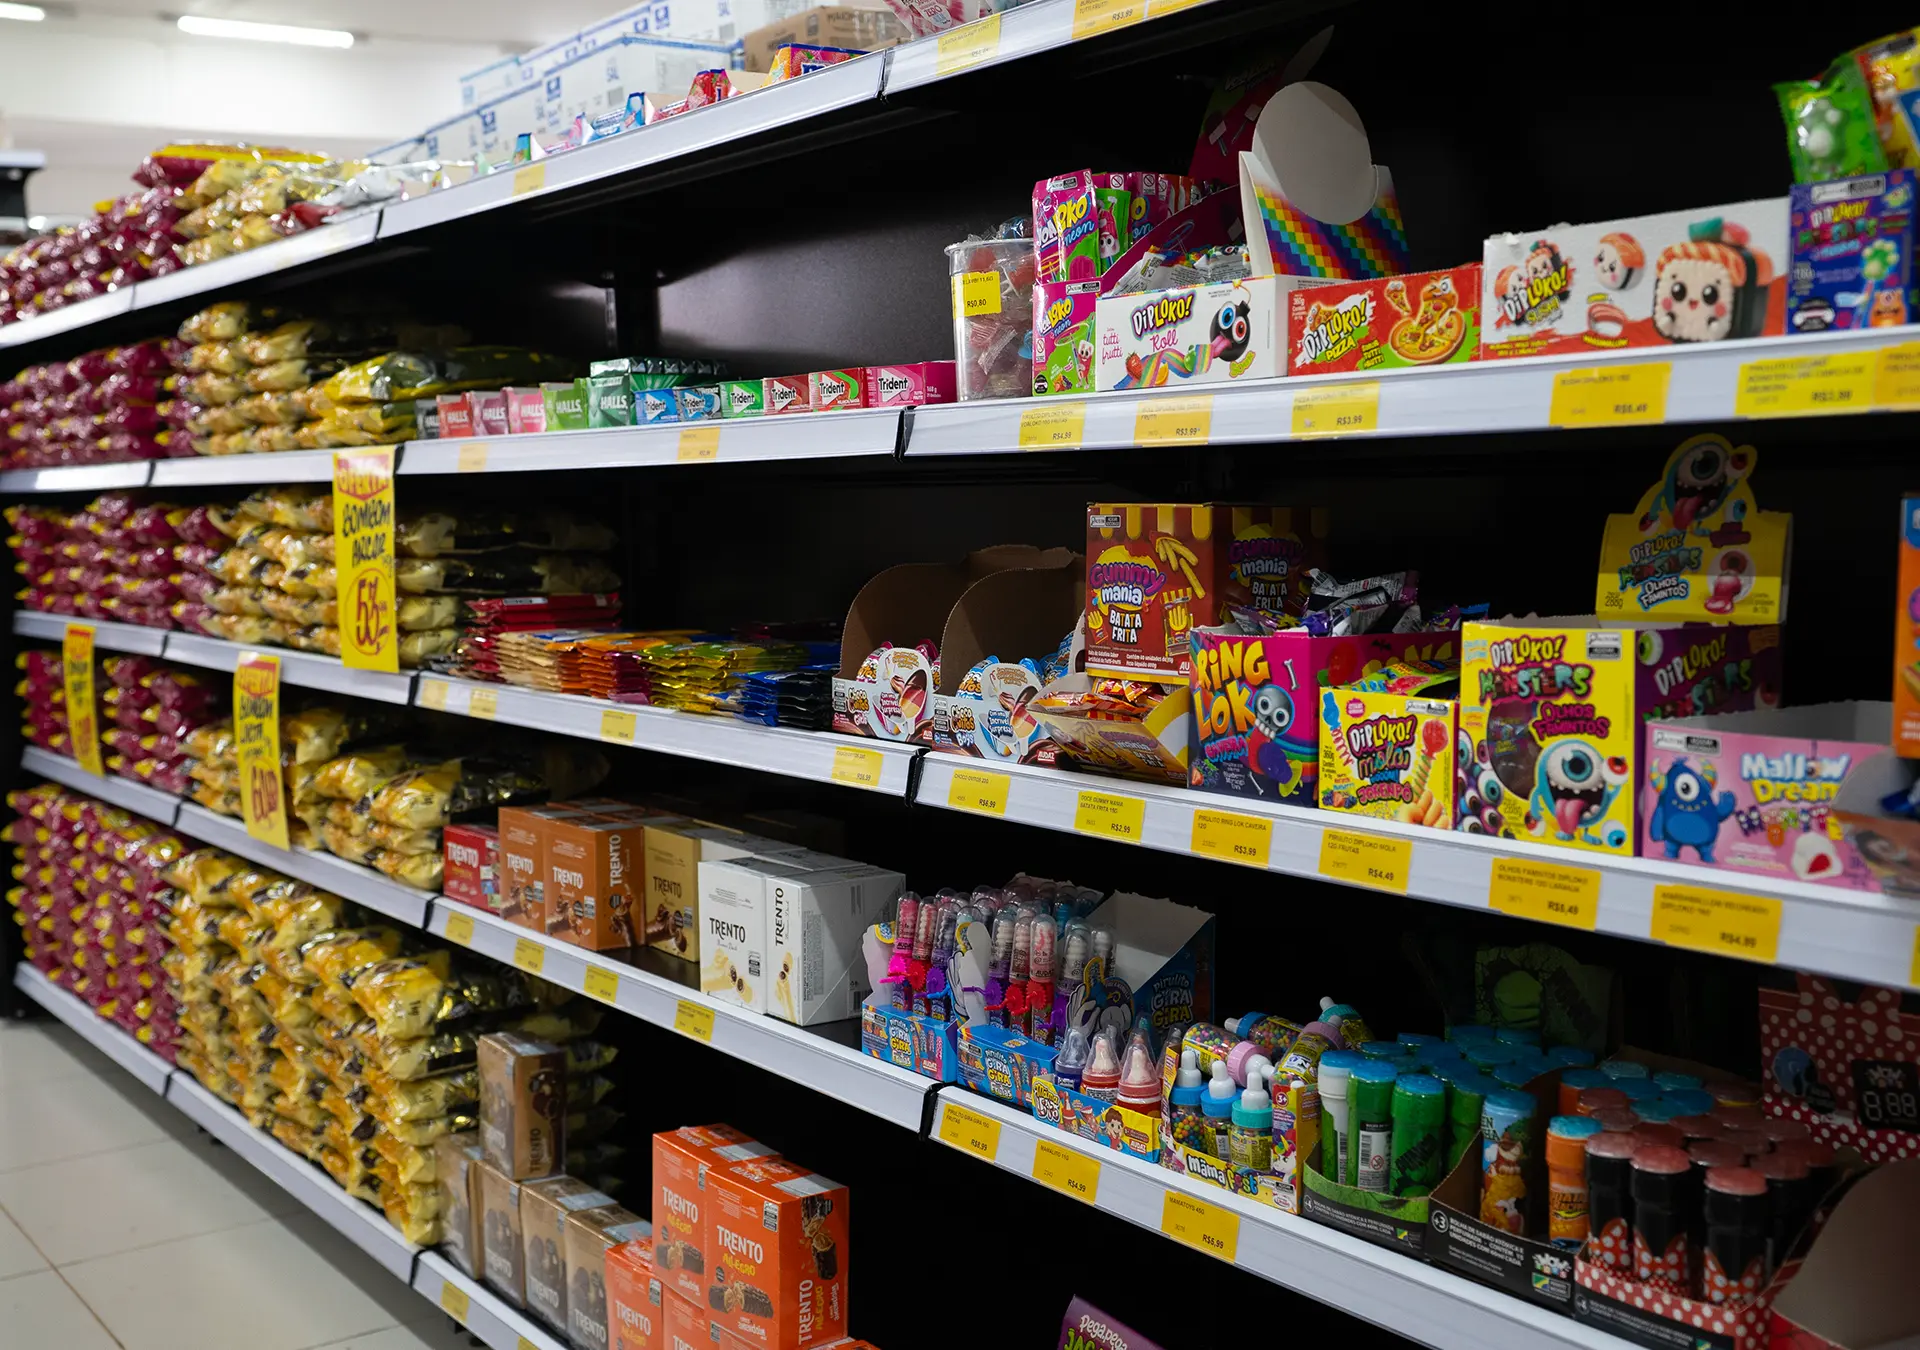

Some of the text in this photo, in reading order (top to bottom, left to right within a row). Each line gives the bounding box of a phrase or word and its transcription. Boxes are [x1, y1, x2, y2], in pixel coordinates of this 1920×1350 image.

[923, 5, 943, 17] ZERO
[1064, 220, 1095, 247] neon
[1150, 329, 1178, 352] Roll
[1325, 335, 1356, 361] PIZZA
[819, 380, 845, 397] Trident
[878, 376, 909, 393] Trident
[600, 395, 627, 410] HALLS
[730, 391, 755, 405] Trident
[772, 387, 796, 403] Trident
[521, 403, 545, 418] HALLS
[556, 400, 581, 414] HALLS
[644, 401, 666, 413] Trident
[683, 398, 705, 410] Trident
[447, 411, 468, 423] HALLS
[482, 406, 505, 420] HALLS
[1241, 557, 1288, 577] mania
[1090, 561, 1168, 597] Gummy
[1252, 580, 1288, 595] BATATA
[1101, 585, 1144, 606] mania
[1640, 583, 1689, 608] FAMINTOS
[1110, 610, 1143, 628] BATATA
[1112, 625, 1138, 644] FRITA
[952, 704, 973, 718] Choco
[1532, 716, 1611, 742] FAMINTOS
[1038, 751, 1055, 760] AUDAZ
[1110, 822, 1131, 834] R$2,99
[1198, 815, 1267, 831] PIRULITO RING LOK CAVEIRA
[1233, 844, 1257, 857] R$3,99
[1328, 834, 1353, 845] PIRULITO
[1353, 837, 1379, 850] DIPLOKO
[1338, 845, 1360, 855] FRUTAS
[447, 841, 480, 868] TRENTO
[609, 834, 621, 888] TRENTO
[507, 852, 534, 875] TRENTO
[552, 866, 584, 890] TRENTO
[1368, 867, 1394, 881] R$4,49
[653, 875, 682, 900] TRENTO
[775, 887, 785, 947] TRENTO
[709, 916, 747, 944] TRENTO
[529, 1128, 541, 1173] TRENTO
[1067, 1178, 1087, 1193] R$4,99
[662, 1186, 699, 1224] TRENTO
[1169, 1196, 1196, 1213] MAMATOYS
[717, 1225, 764, 1265] TRENTO
[1202, 1233, 1224, 1250] R$5,99
[615, 1300, 652, 1336] TRENTO
[799, 1279, 814, 1346] TRENTO
